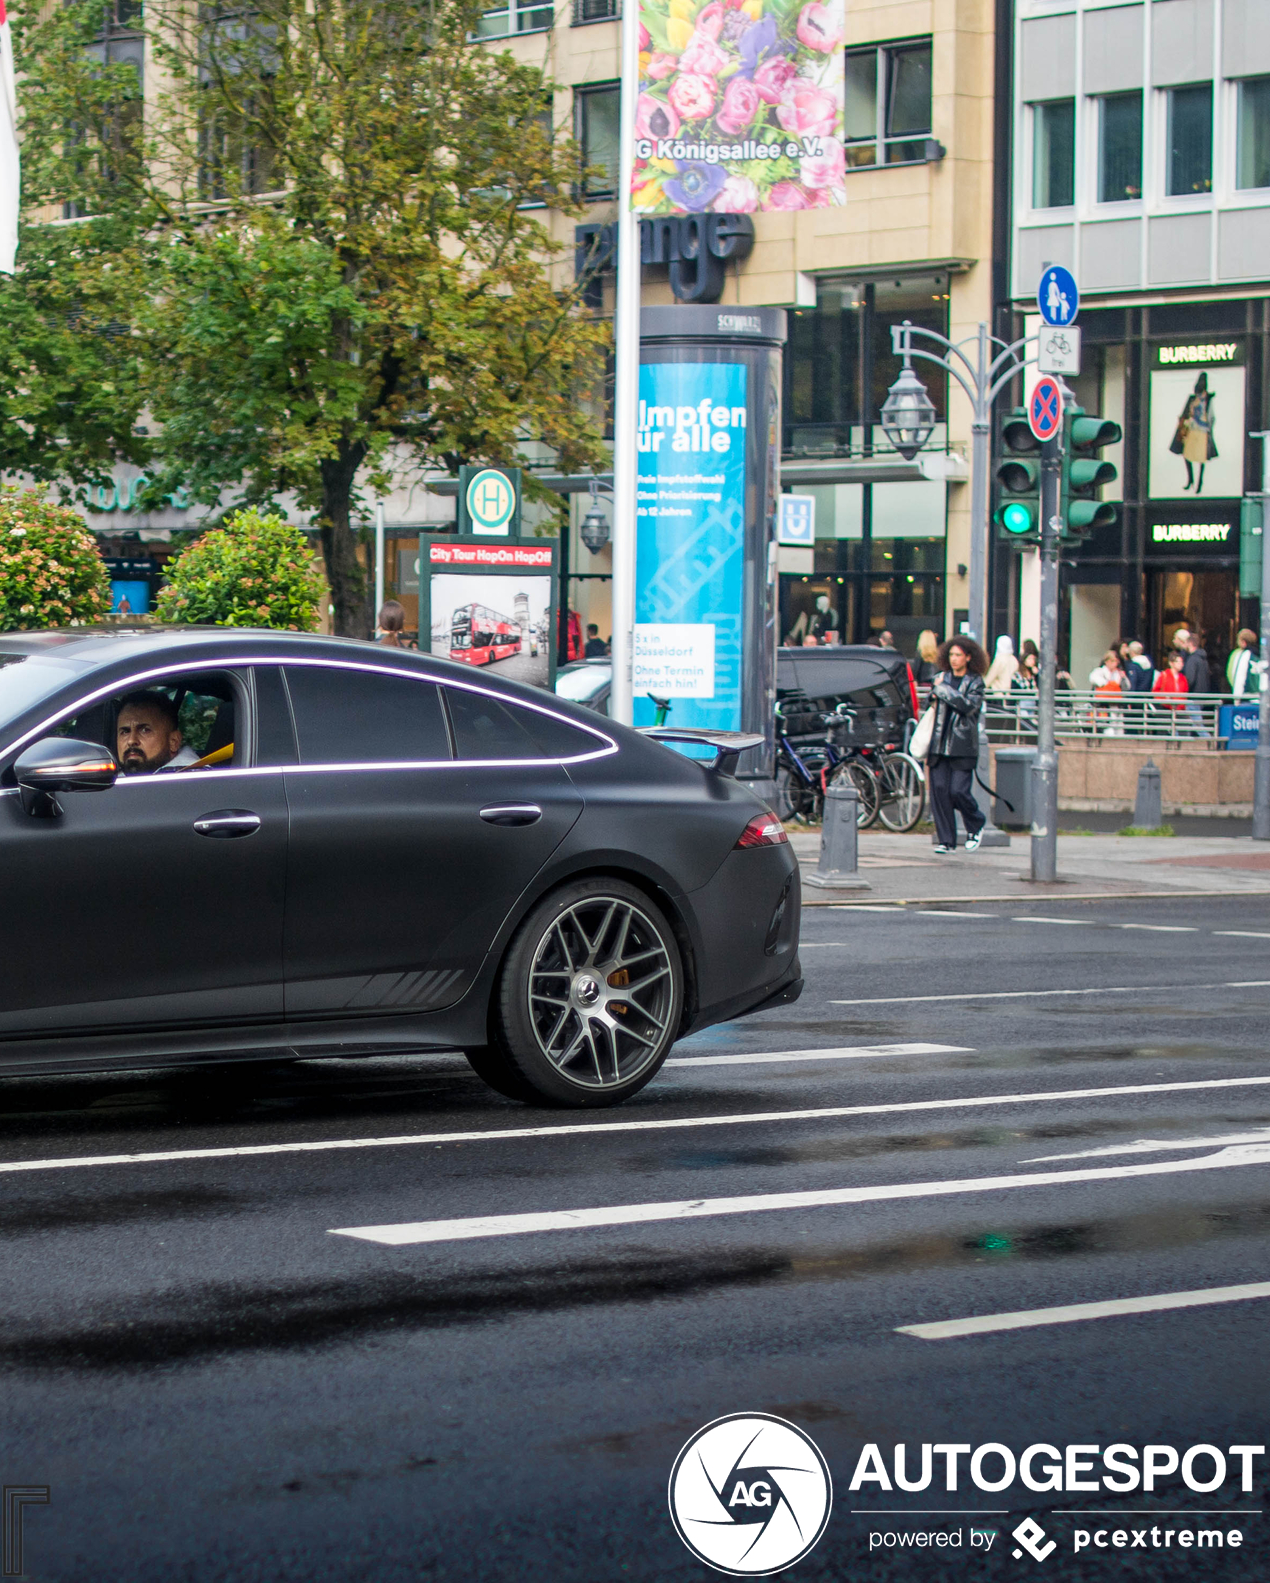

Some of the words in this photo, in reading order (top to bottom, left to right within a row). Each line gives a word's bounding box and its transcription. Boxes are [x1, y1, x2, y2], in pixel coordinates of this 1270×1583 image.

[657, 139, 782, 164] Königsallee
[785, 136, 824, 158] e.V.
[1158, 343, 1237, 364] BURBERRY
[671, 423, 731, 453] alle
[483, 484, 500, 516] H
[648, 506, 658, 516] 12
[658, 506, 692, 516] Jahren
[1153, 524, 1230, 541] BURBERRY
[430, 548, 450, 562] City
[452, 548, 476, 561] Tour
[476, 549, 513, 564] HopOn
[514, 550, 552, 565] HopOff
[643, 635, 648, 643] x
[650, 634, 661, 643] in
[635, 646, 693, 656] Düsseldorf
[634, 665, 661, 675] Ohne
[663, 665, 705, 675] Termin
[634, 679, 672, 688] einfach
[675, 678, 698, 688] hin!
